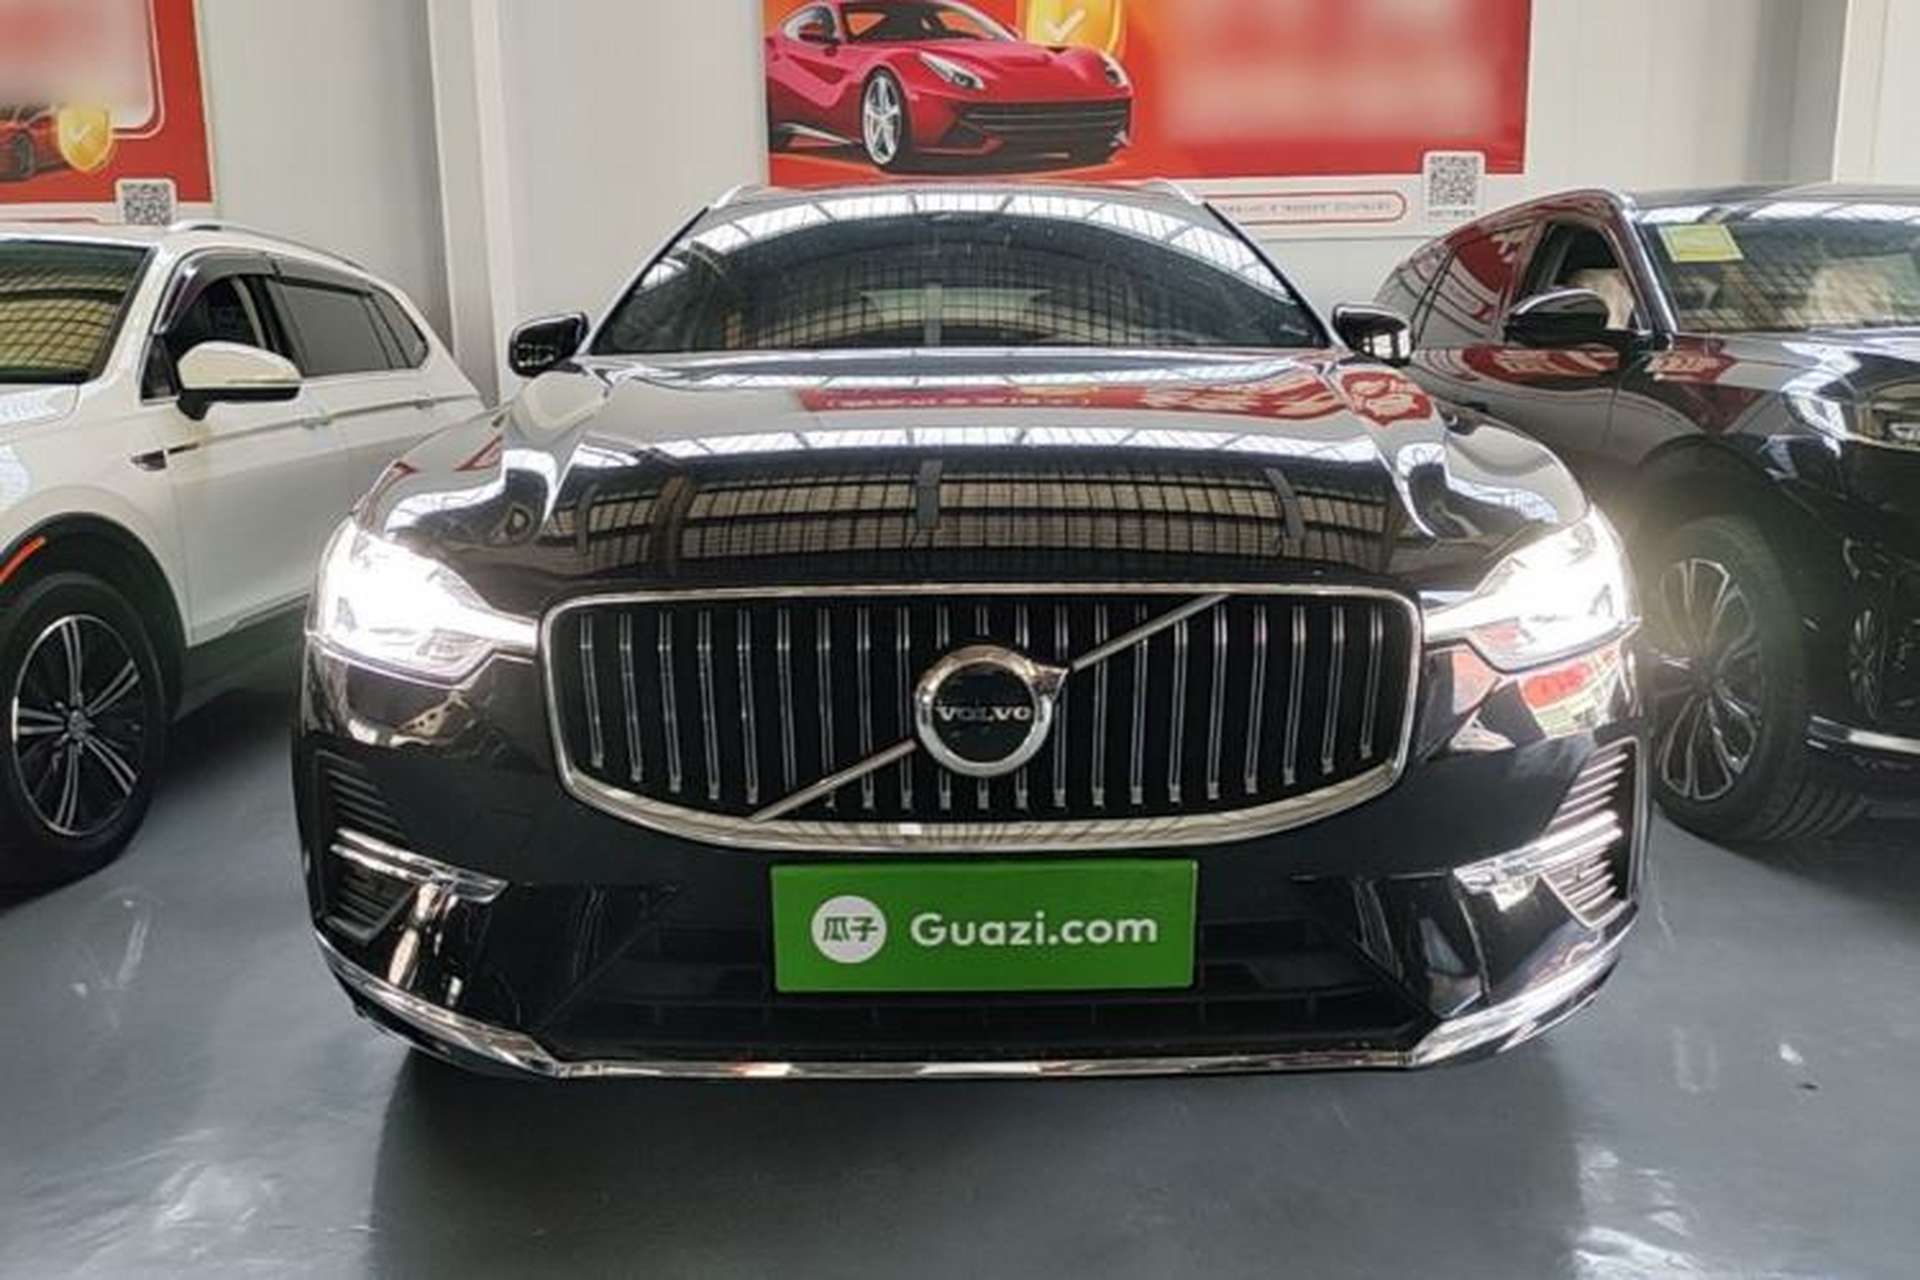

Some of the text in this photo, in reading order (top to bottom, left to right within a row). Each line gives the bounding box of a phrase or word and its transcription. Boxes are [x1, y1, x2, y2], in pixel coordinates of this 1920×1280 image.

[935, 706, 1032, 721] VOLVO
[823, 916, 878, 942] 瓜子
[910, 911, 1157, 946] Guazi.com
